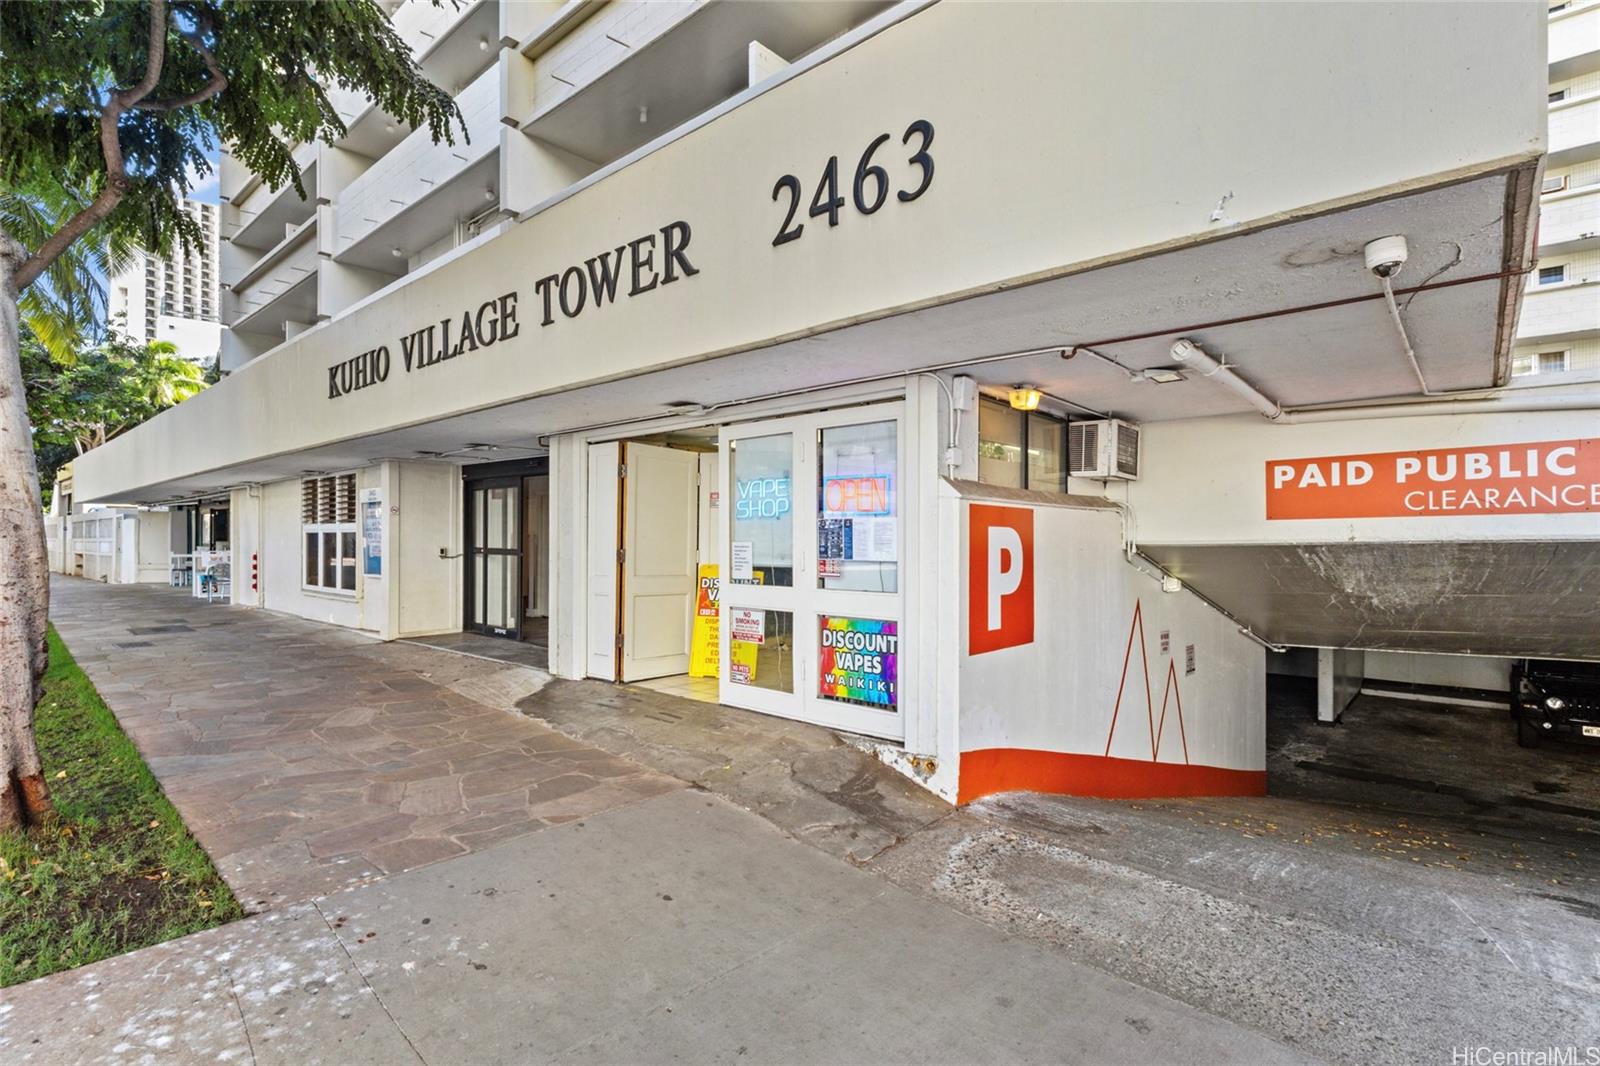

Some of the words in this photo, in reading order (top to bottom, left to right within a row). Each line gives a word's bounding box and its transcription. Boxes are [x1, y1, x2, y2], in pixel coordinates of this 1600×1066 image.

[771, 119, 935, 247] 2463
[327, 345, 390, 400] KUHIO
[399, 290, 521, 373] VILLAGE
[535, 219, 700, 327] TOWER
[1273, 460, 1374, 490] PAID
[1395, 446, 1577, 484] PUBLIC
[737, 478, 790, 499] VAPE
[825, 478, 886, 512] OPEN
[1404, 484, 1600, 511] CLEARANCE
[736, 497, 789, 519] SHOP
[986, 525, 1024, 632] P
[735, 616, 760, 626] SMOKING
[822, 628, 897, 654] DISCOUNT
[835, 651, 882, 675] VAPES
[825, 673, 894, 693] WAIKIKI
